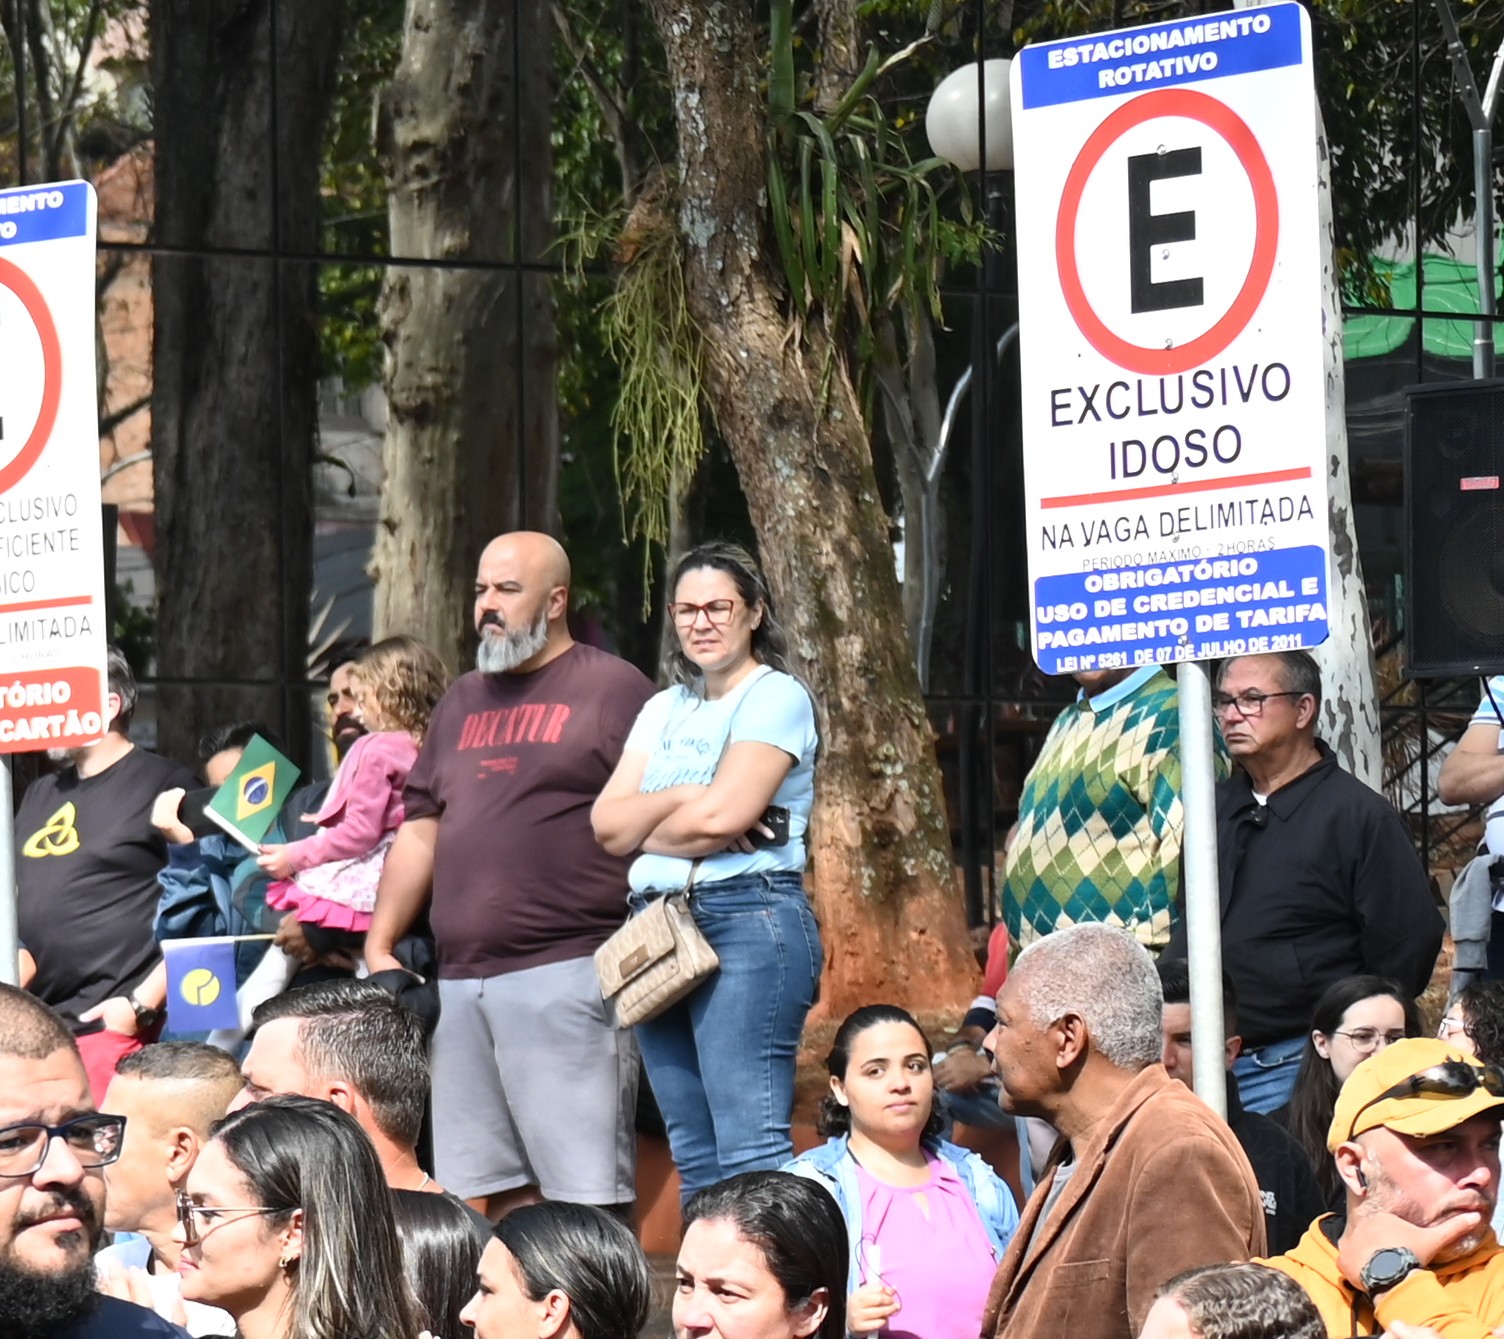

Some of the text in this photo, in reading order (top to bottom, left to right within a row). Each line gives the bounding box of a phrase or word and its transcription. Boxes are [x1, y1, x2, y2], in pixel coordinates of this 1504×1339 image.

[1047, 13, 1271, 69] ESTACIONAMENTO
[1098, 50, 1219, 88] ROTATIVO
[1127, 145, 1204, 315] E
[1050, 361, 1292, 428] EXCLUSIVO
[1109, 424, 1242, 481] IDOSO
[1041, 494, 1314, 551] NA VAGA DELIMITADA
[1084, 556, 1258, 594] OBRIGATÓRIO
[1037, 577, 1319, 625] USO DE CREDENCIAL E
[1038, 602, 1328, 650] PAGAMENTO DE TARIFA
[1056, 657, 1078, 673] LEI
[1133, 649, 1154, 665] DE
[1156, 647, 1172, 663] 07
[1175, 644, 1195, 661] DE
[1198, 638, 1246, 658] JULHO
[1248, 636, 1269, 652] DE
[1271, 633, 1303, 650] 2011
[458, 703, 571, 751] DECATUR
